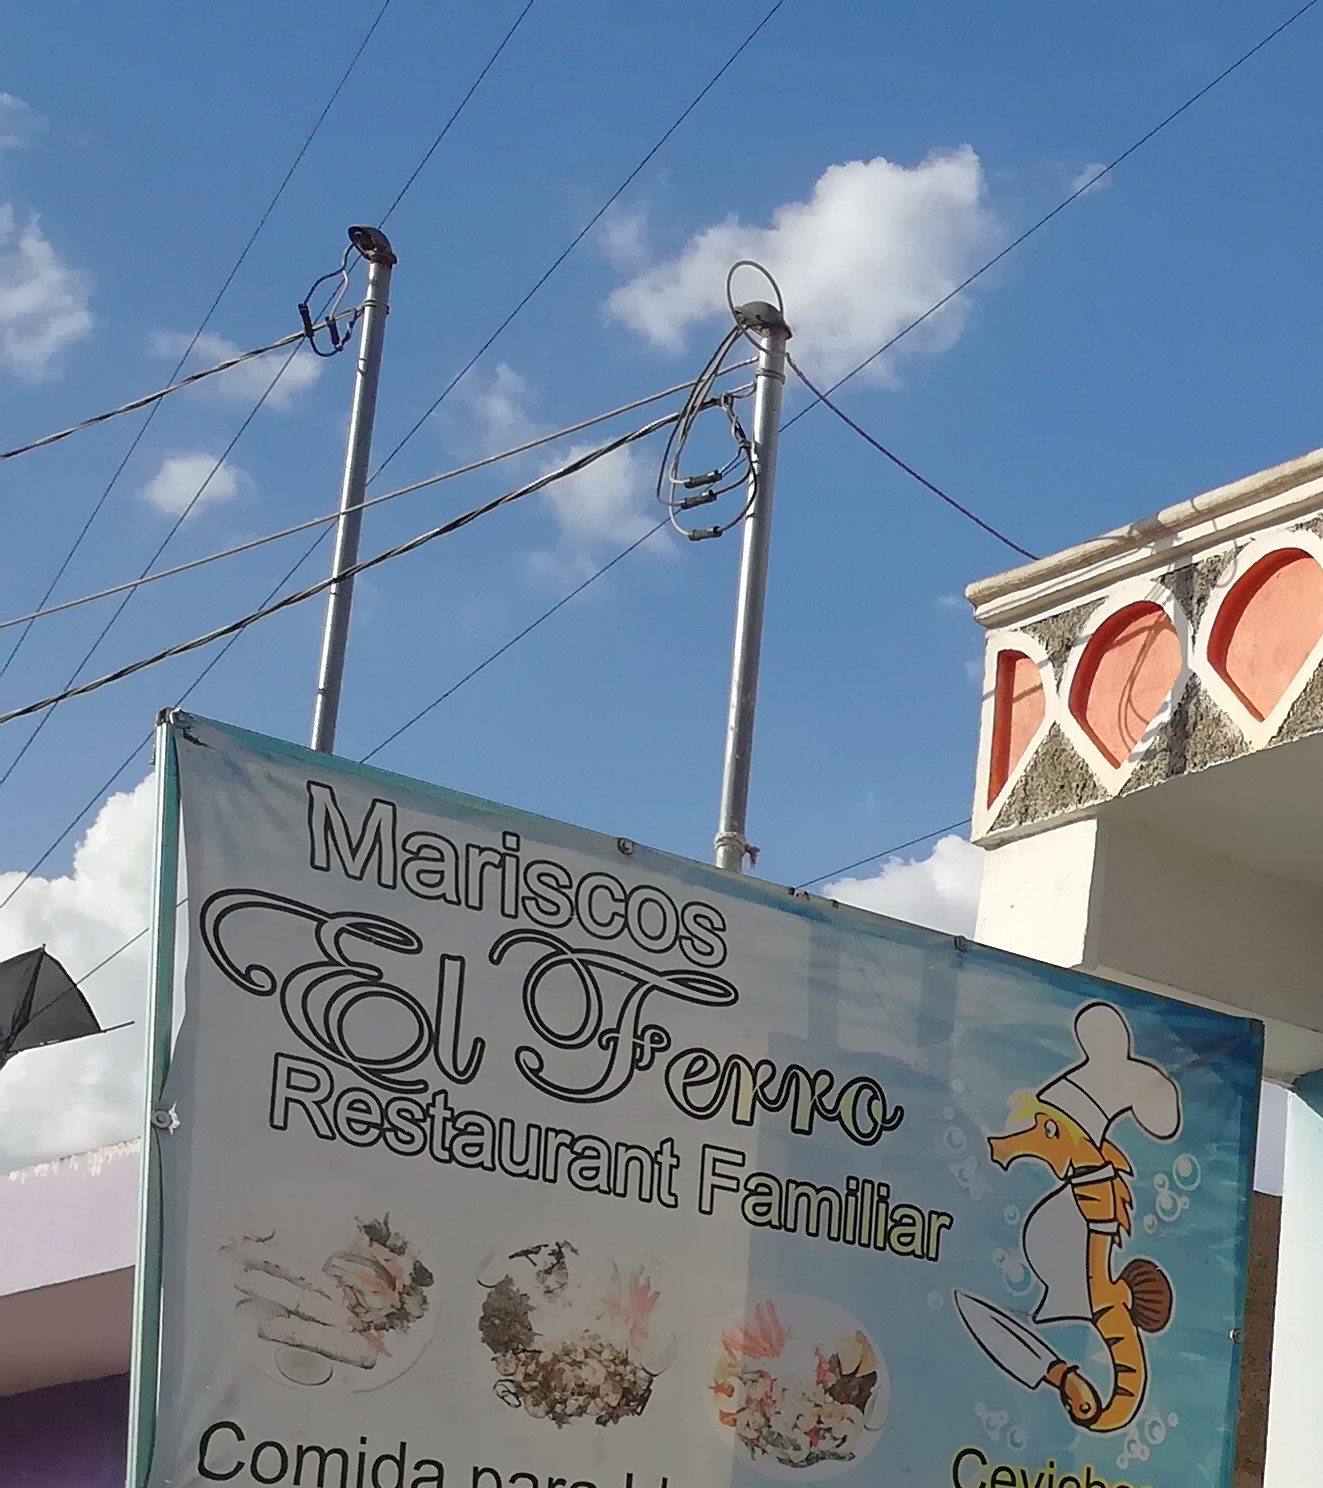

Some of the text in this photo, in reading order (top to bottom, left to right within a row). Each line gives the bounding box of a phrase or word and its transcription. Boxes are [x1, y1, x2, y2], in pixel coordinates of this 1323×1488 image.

[306, 779, 728, 969] Mariscos
[199, 887, 905, 1147] El Ferro
[268, 1051, 954, 1262] Restaurant Familiar
